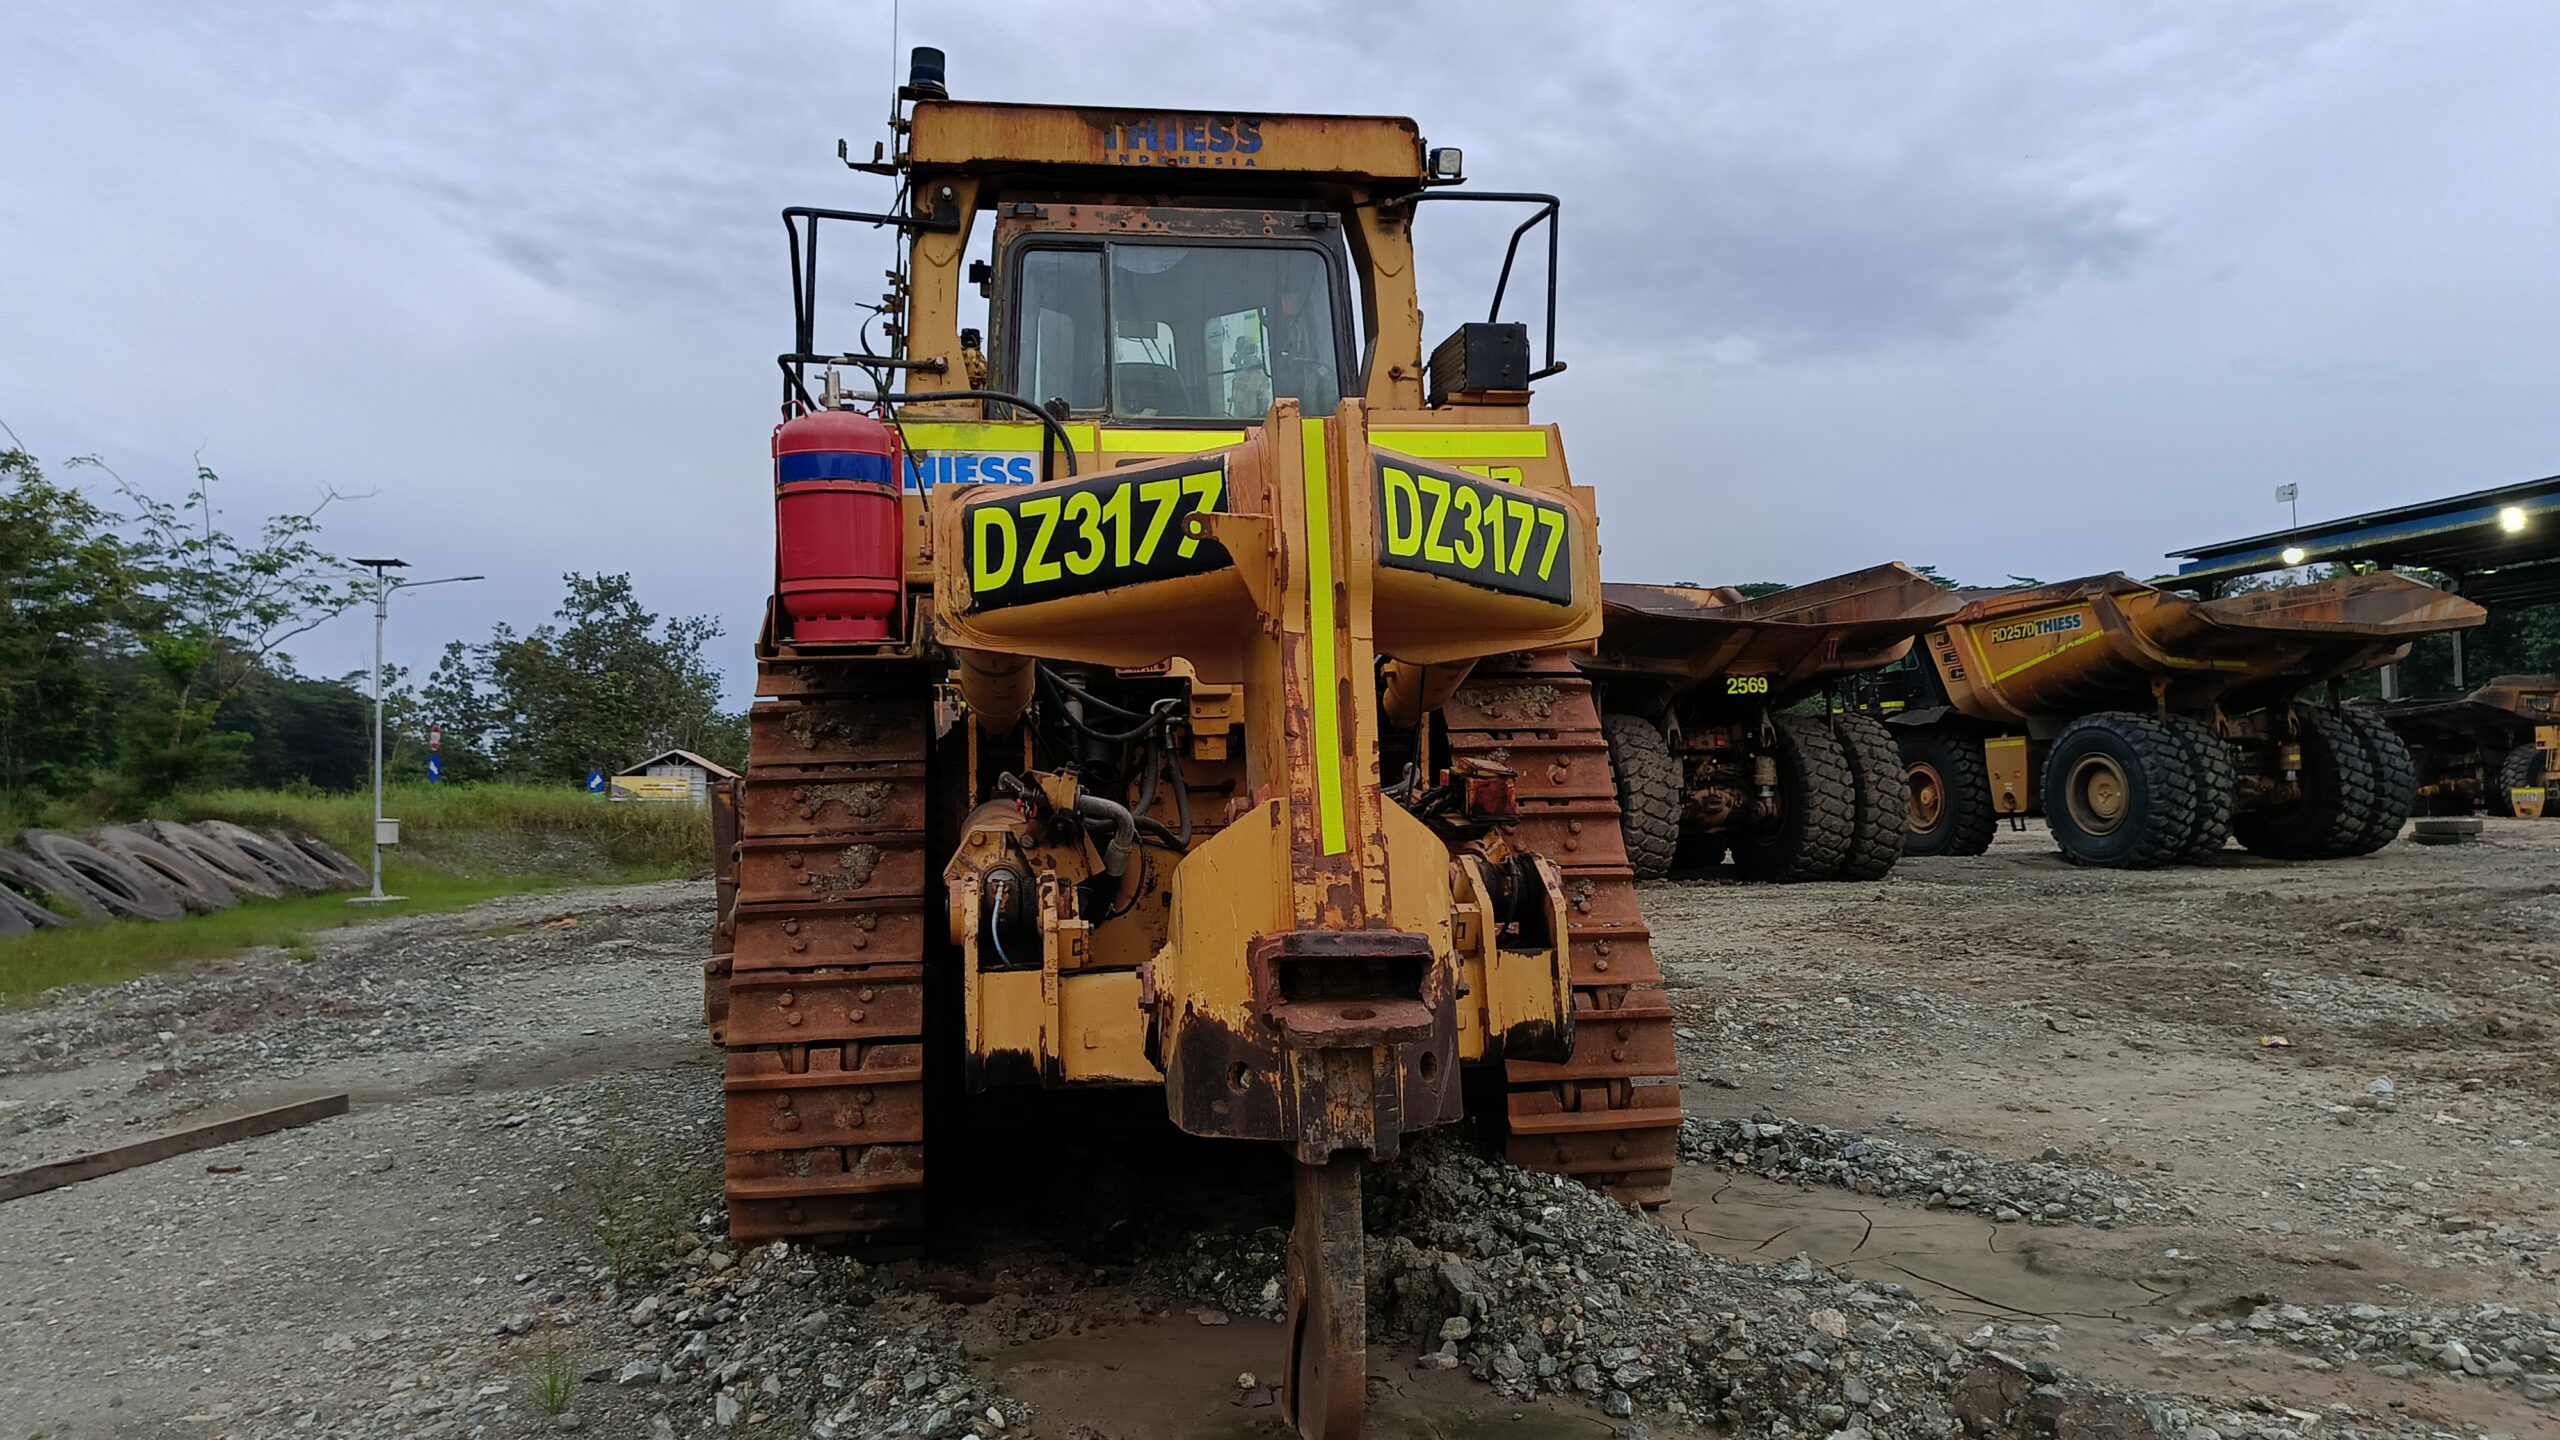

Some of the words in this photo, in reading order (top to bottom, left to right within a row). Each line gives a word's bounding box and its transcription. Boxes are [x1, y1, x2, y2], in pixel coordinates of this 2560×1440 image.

[1104, 154, 1256, 168] INDONESIA
[903, 457, 1034, 488] HIESS
[973, 470, 1223, 593] DZ3177
[1383, 466, 1565, 582] DZ3177
[1991, 622, 2035, 644] RD2570
[2035, 614, 2082, 636] THIESS
[1726, 677, 1768, 695] 2569
